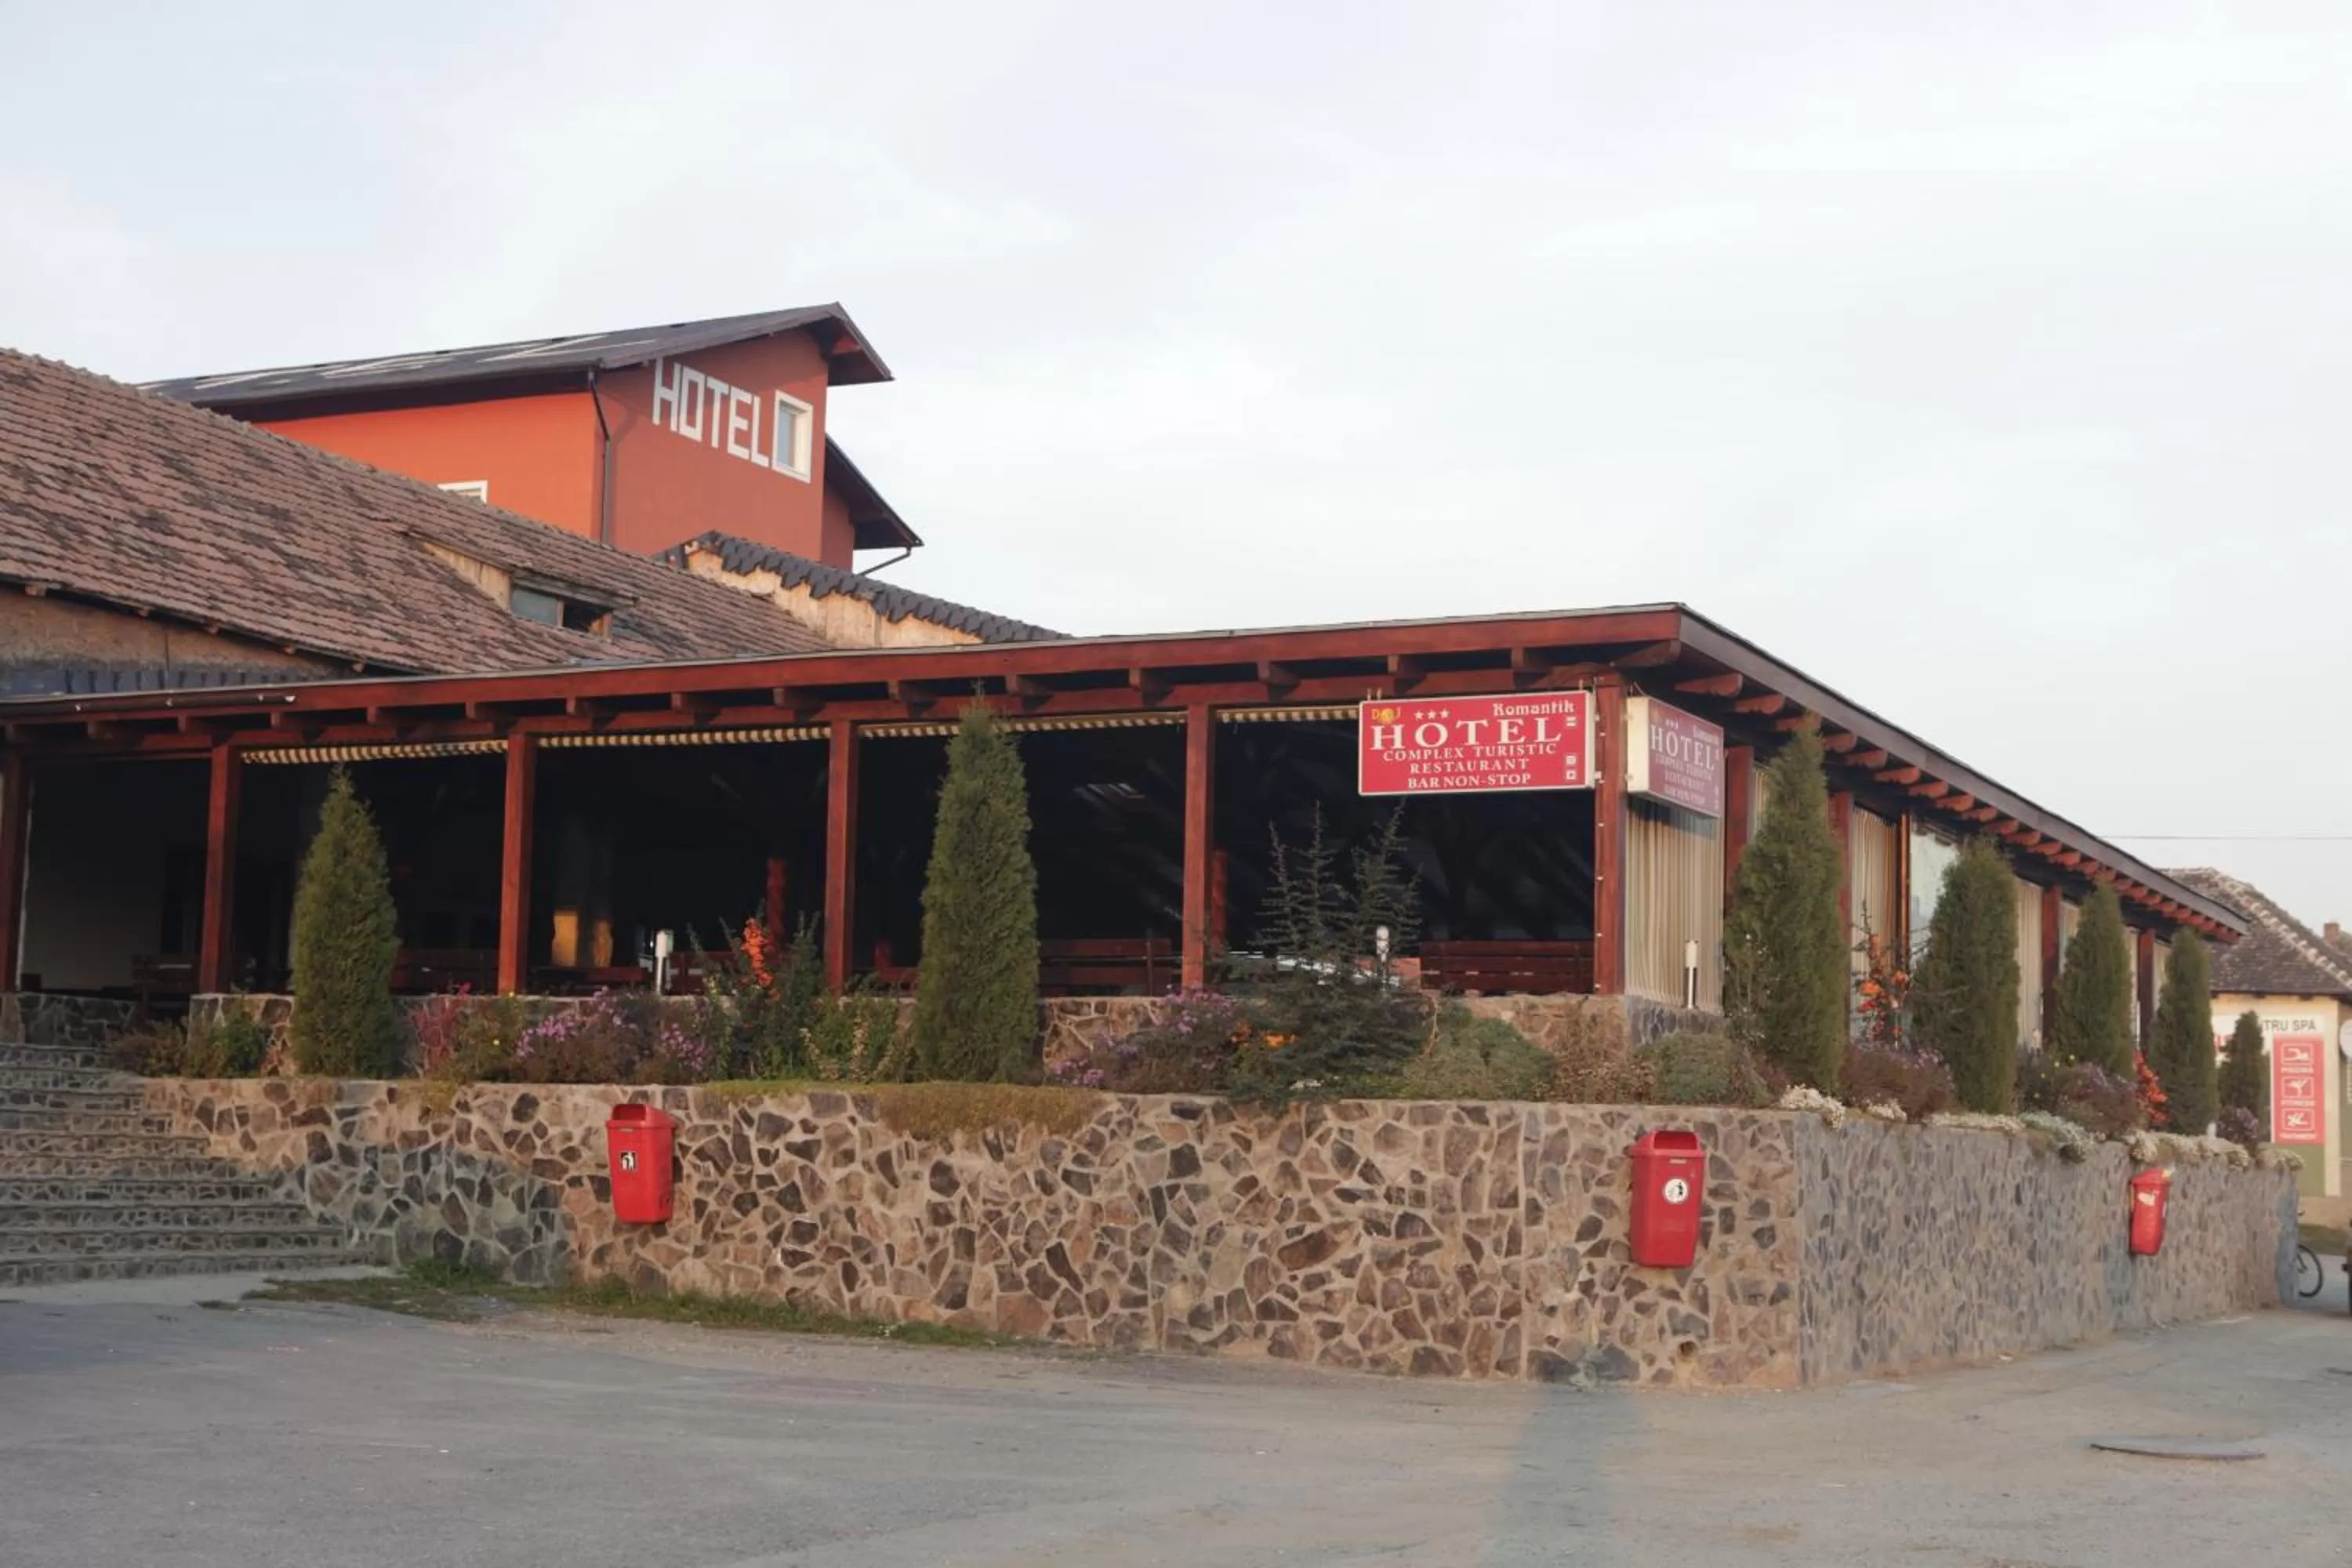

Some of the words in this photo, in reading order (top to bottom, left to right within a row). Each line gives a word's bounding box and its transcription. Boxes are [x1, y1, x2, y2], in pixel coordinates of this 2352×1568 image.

[652, 356, 770, 468] HOTEL
[1492, 699, 1575, 716] Romantik
[1370, 717, 1563, 750] HOTEL
[1382, 747, 1465, 762] COMPLEX
[1473, 742, 1557, 757] TURISTIC
[1650, 724, 1715, 771] HOTEL
[1409, 757, 1530, 775] RESTAURANT
[1407, 777, 1441, 789] BAR
[1443, 773, 1531, 787] NON-STOP
[2259, 1019, 2288, 1031] TRU
[2292, 1019, 2317, 1031] SPA
